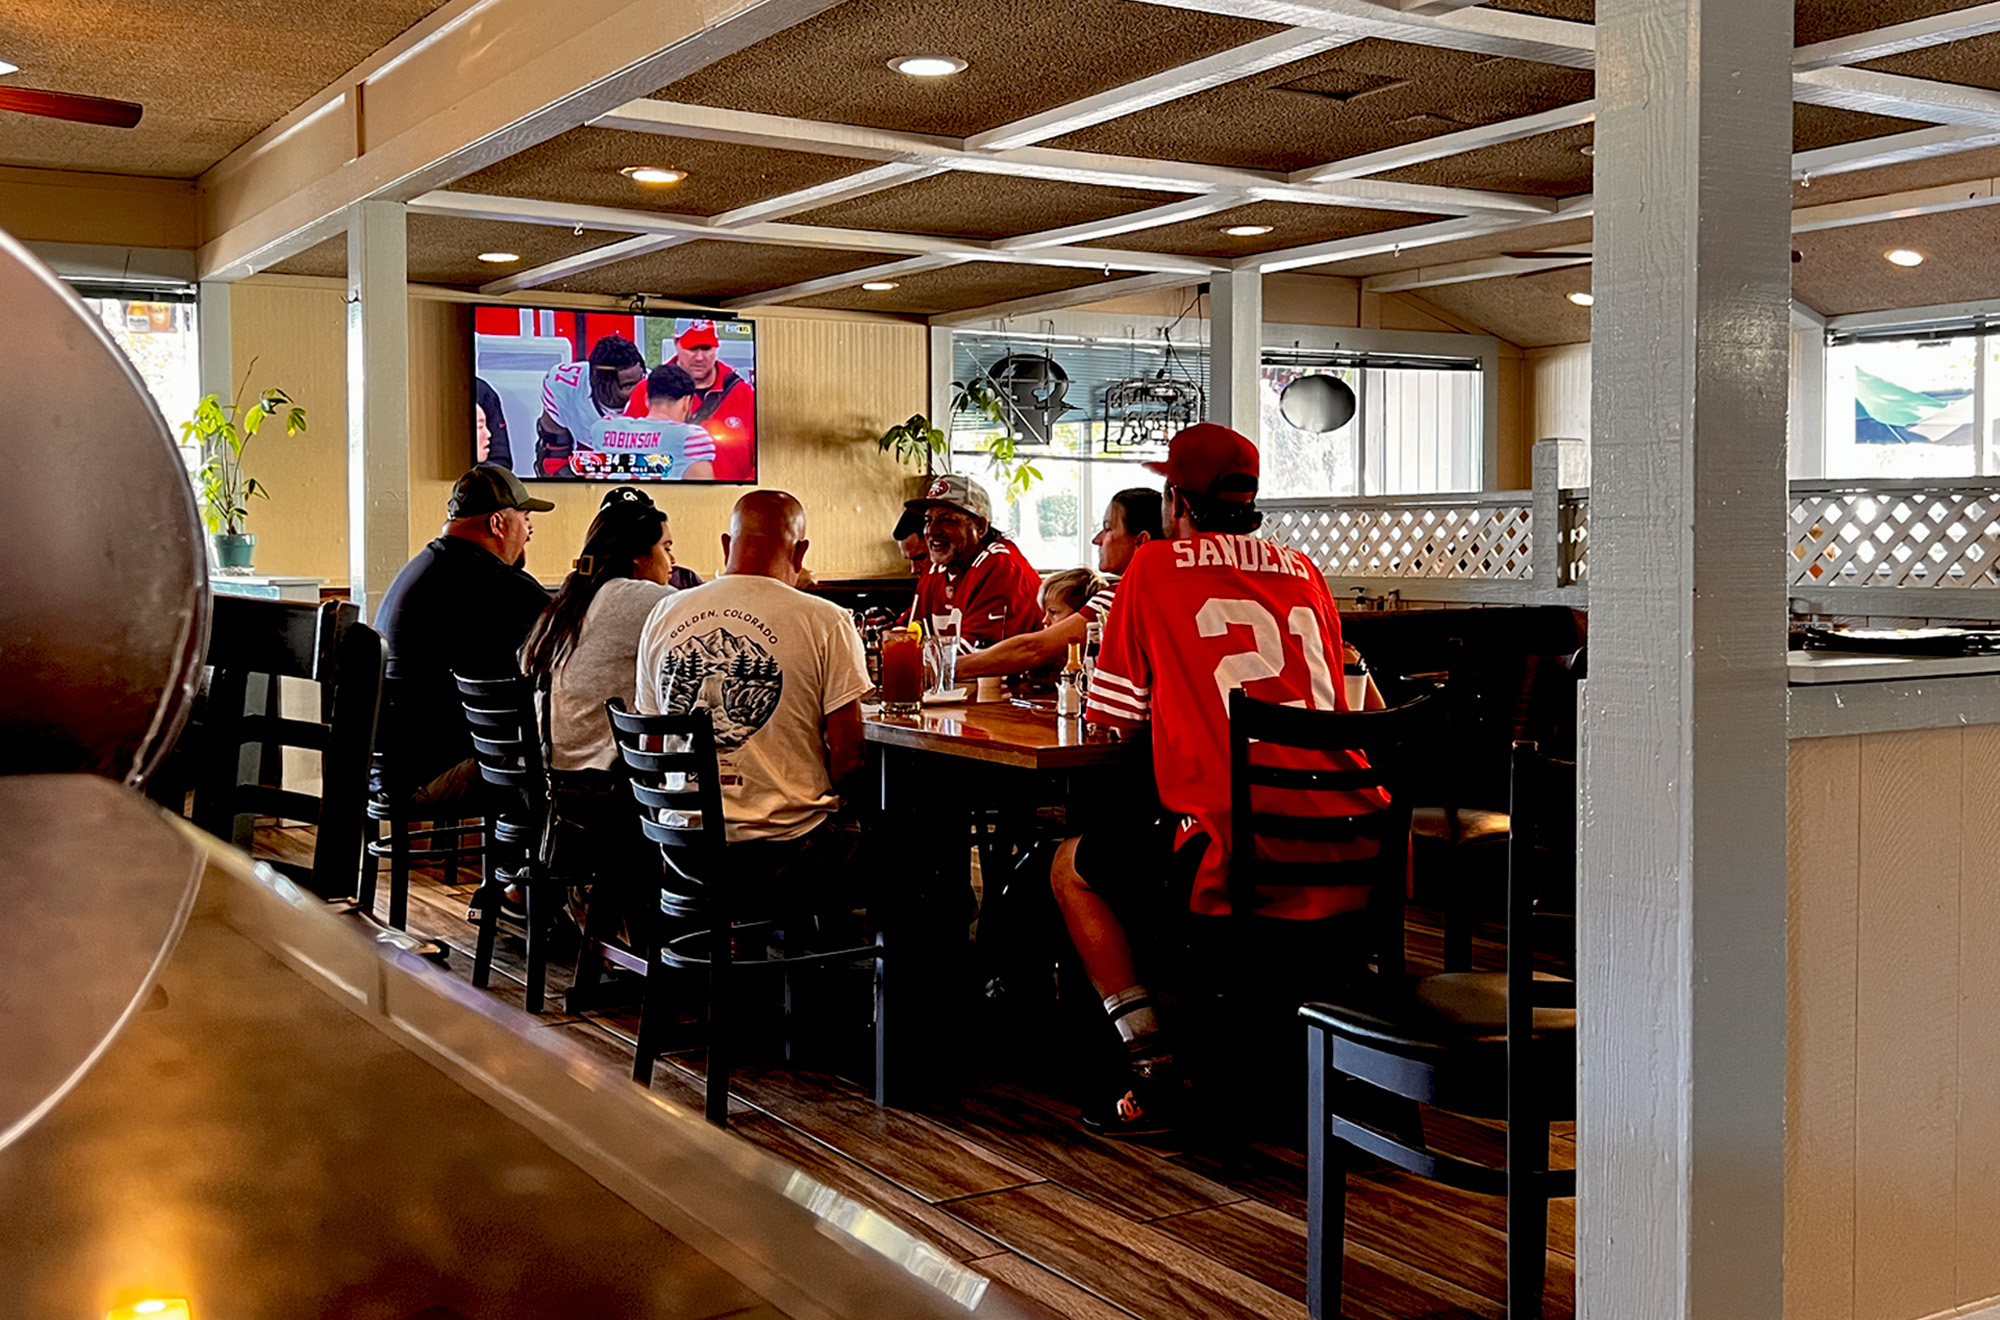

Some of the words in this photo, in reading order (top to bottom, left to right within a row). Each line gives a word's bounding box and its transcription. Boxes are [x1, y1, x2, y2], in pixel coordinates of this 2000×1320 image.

[602, 431, 661, 448] ROBINSON
[605, 454, 620, 466] 34
[628, 454, 636, 466] 3
[669, 609, 719, 639] GOLDEN,
[723, 608, 779, 645] COLORADO
[1195, 597, 1335, 720] 21
